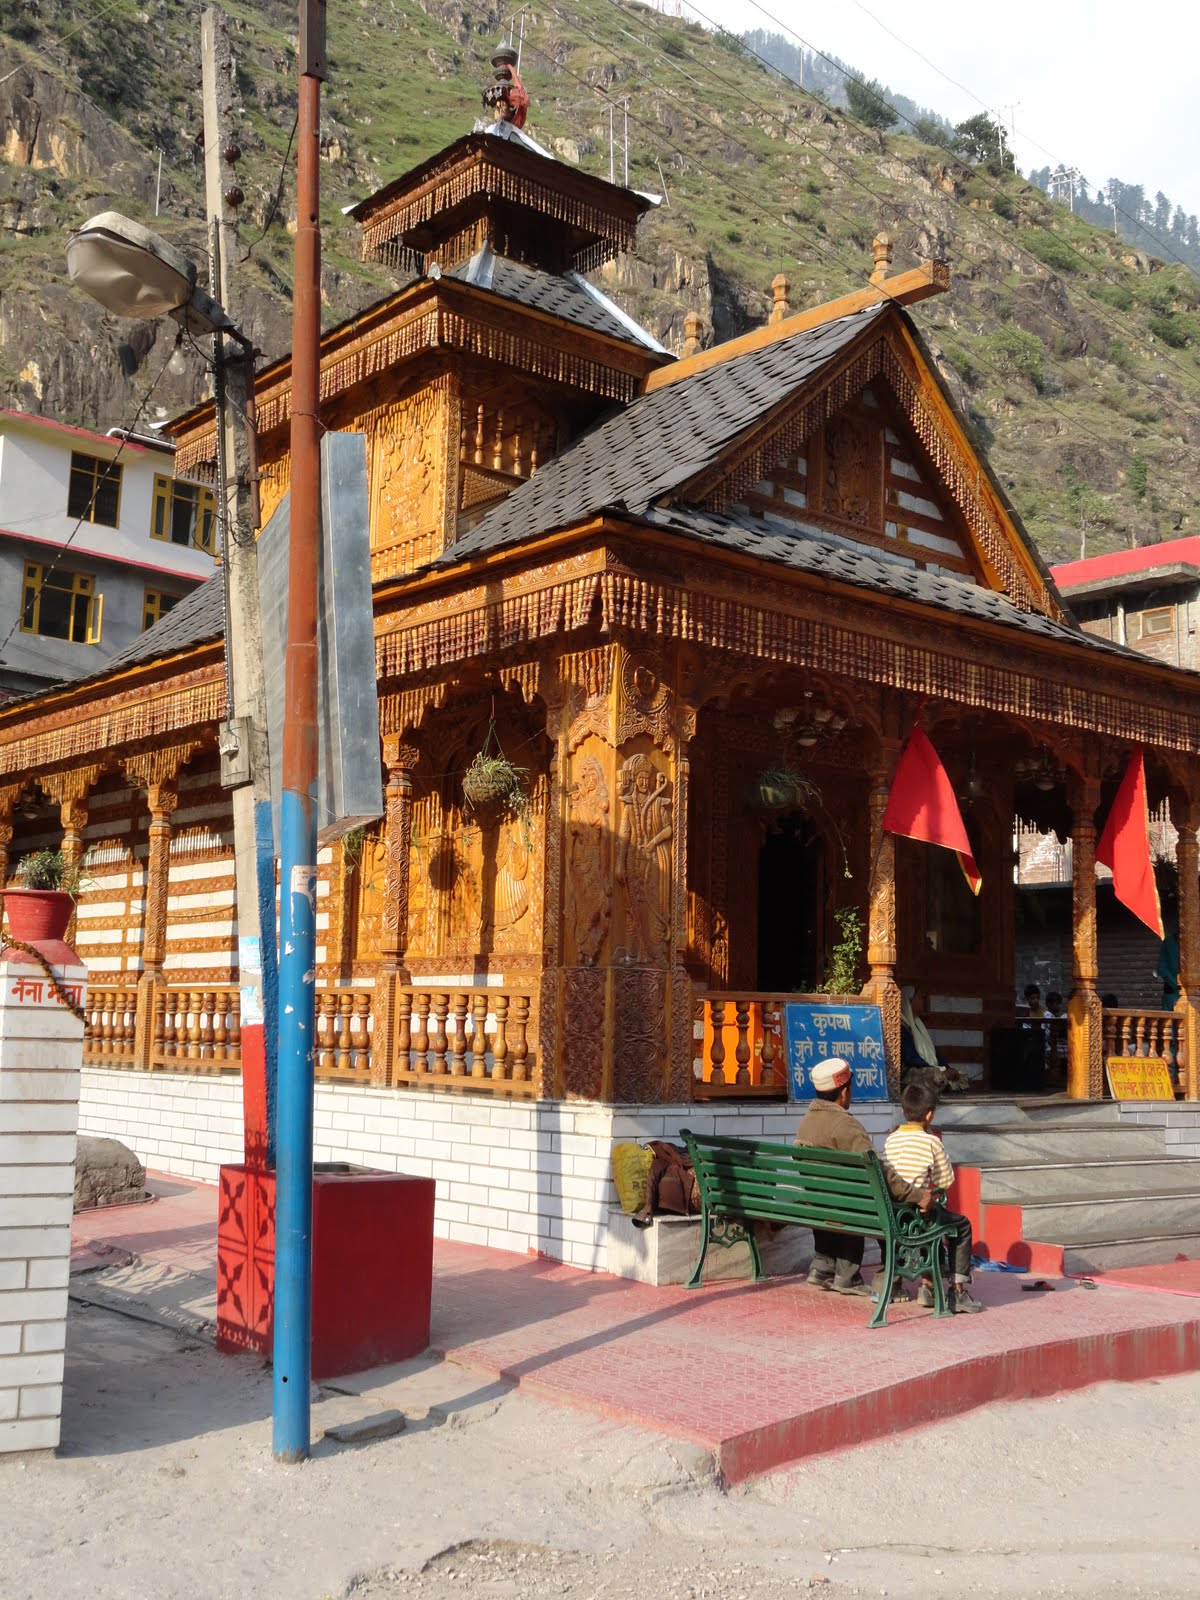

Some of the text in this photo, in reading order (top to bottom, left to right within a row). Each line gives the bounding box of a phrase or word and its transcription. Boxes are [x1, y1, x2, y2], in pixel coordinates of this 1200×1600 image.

[47, 983, 83, 1005] मता
[811, 1012, 851, 1036] कृपया
[817, 1041, 828, 1057] व
[832, 1041, 854, 1060] चप्पल
[793, 1062, 805, 1088] के
